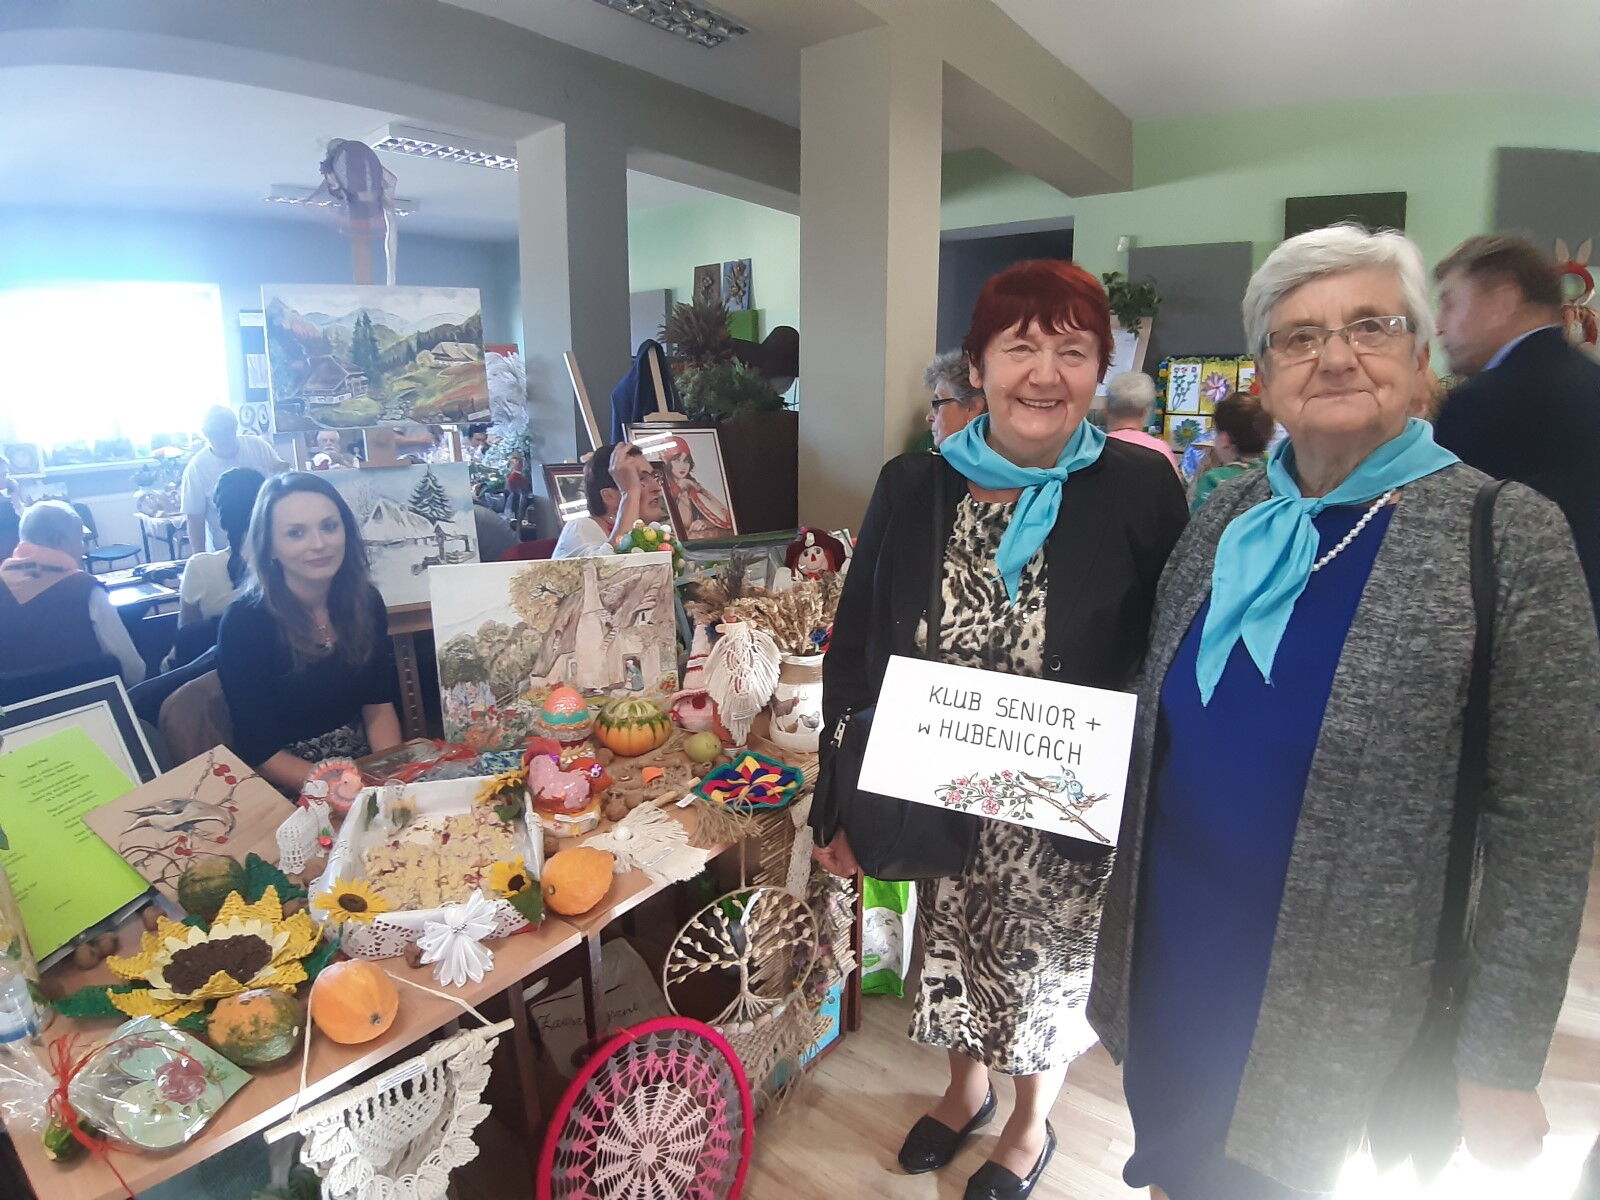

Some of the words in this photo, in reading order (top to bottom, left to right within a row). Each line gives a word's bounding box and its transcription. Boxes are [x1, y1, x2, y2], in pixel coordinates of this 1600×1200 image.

[929, 685, 982, 711] KLUB
[995, 697, 1076, 731] SENIOR
[1085, 717, 1102, 731] +
[939, 718, 1082, 765] HUBENICACH
